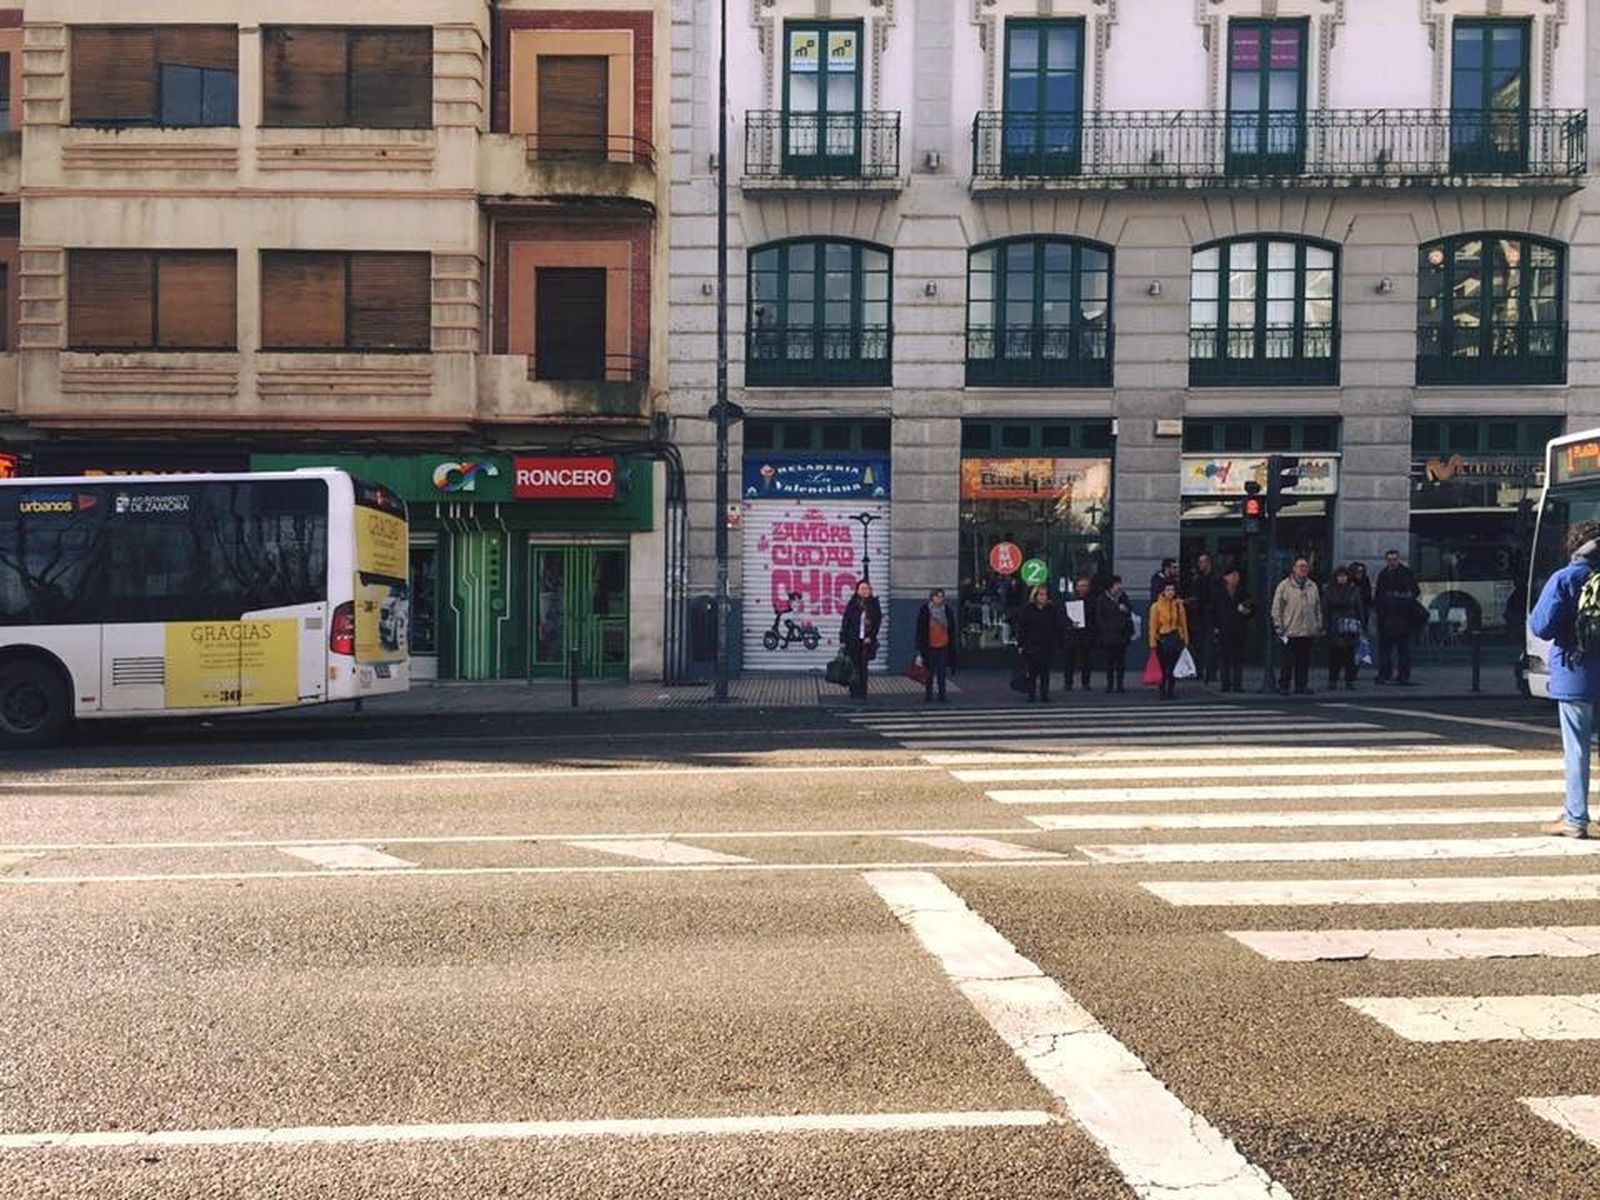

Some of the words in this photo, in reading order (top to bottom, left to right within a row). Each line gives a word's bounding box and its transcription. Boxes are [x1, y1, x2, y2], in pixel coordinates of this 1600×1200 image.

[516, 469, 612, 486] RONCERO
[775, 481, 862, 494] Valenciana
[20, 500, 73, 513] urbanos
[145, 501, 190, 512] ZAMORA
[772, 522, 853, 542] ZAMORA
[771, 545, 855, 568] CIUDAD
[1028, 562, 1041, 582] 2
[190, 623, 273, 643] GRACIAS
